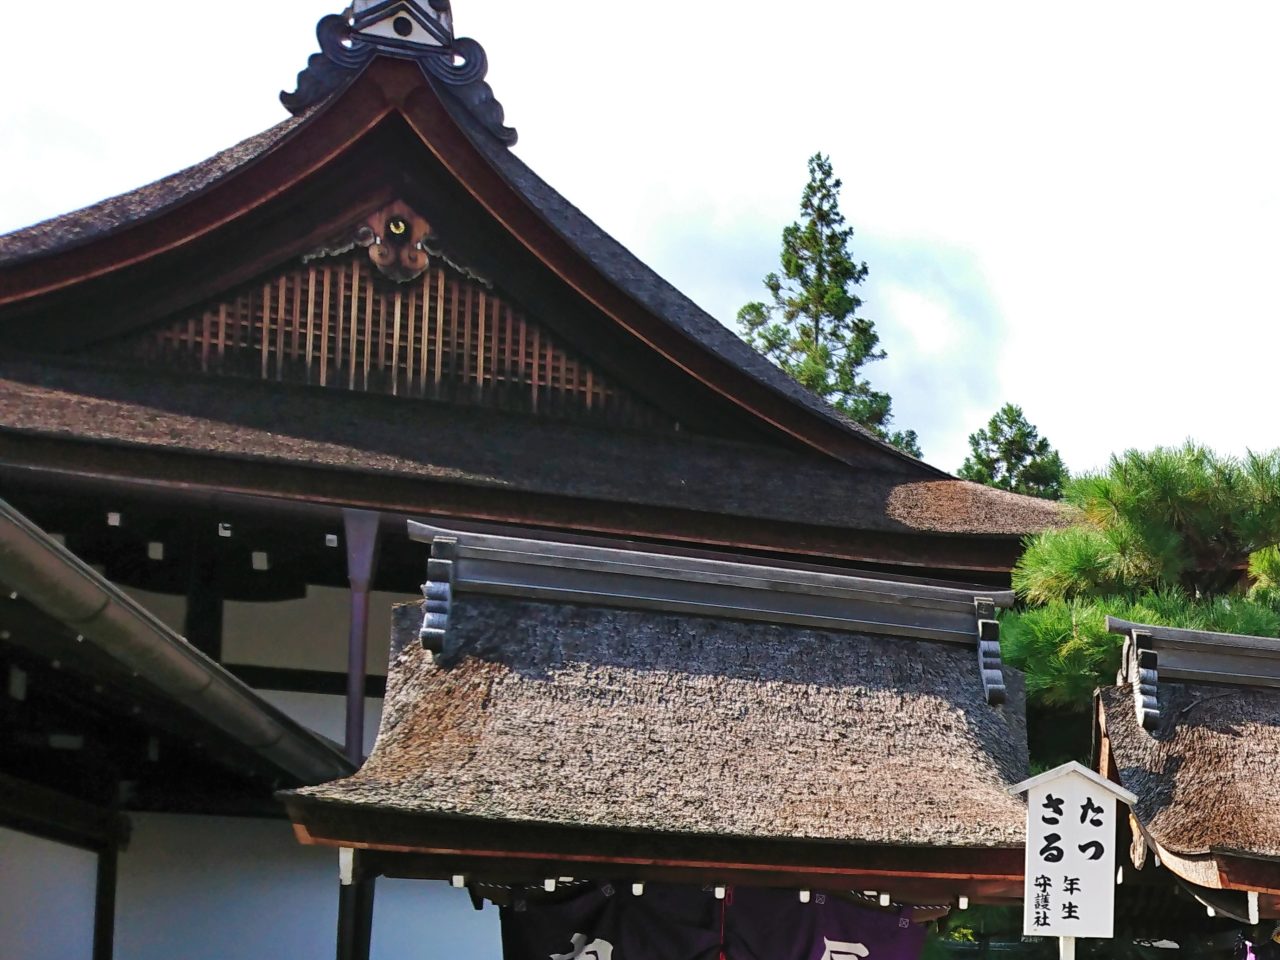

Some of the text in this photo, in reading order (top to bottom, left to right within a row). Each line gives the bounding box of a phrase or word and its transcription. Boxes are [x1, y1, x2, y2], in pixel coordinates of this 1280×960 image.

[1039, 793, 1065, 863] さる
[1078, 796, 1105, 861] たつ
[1033, 874, 1053, 927] 守護社
[1061, 875, 1082, 921] 年生
